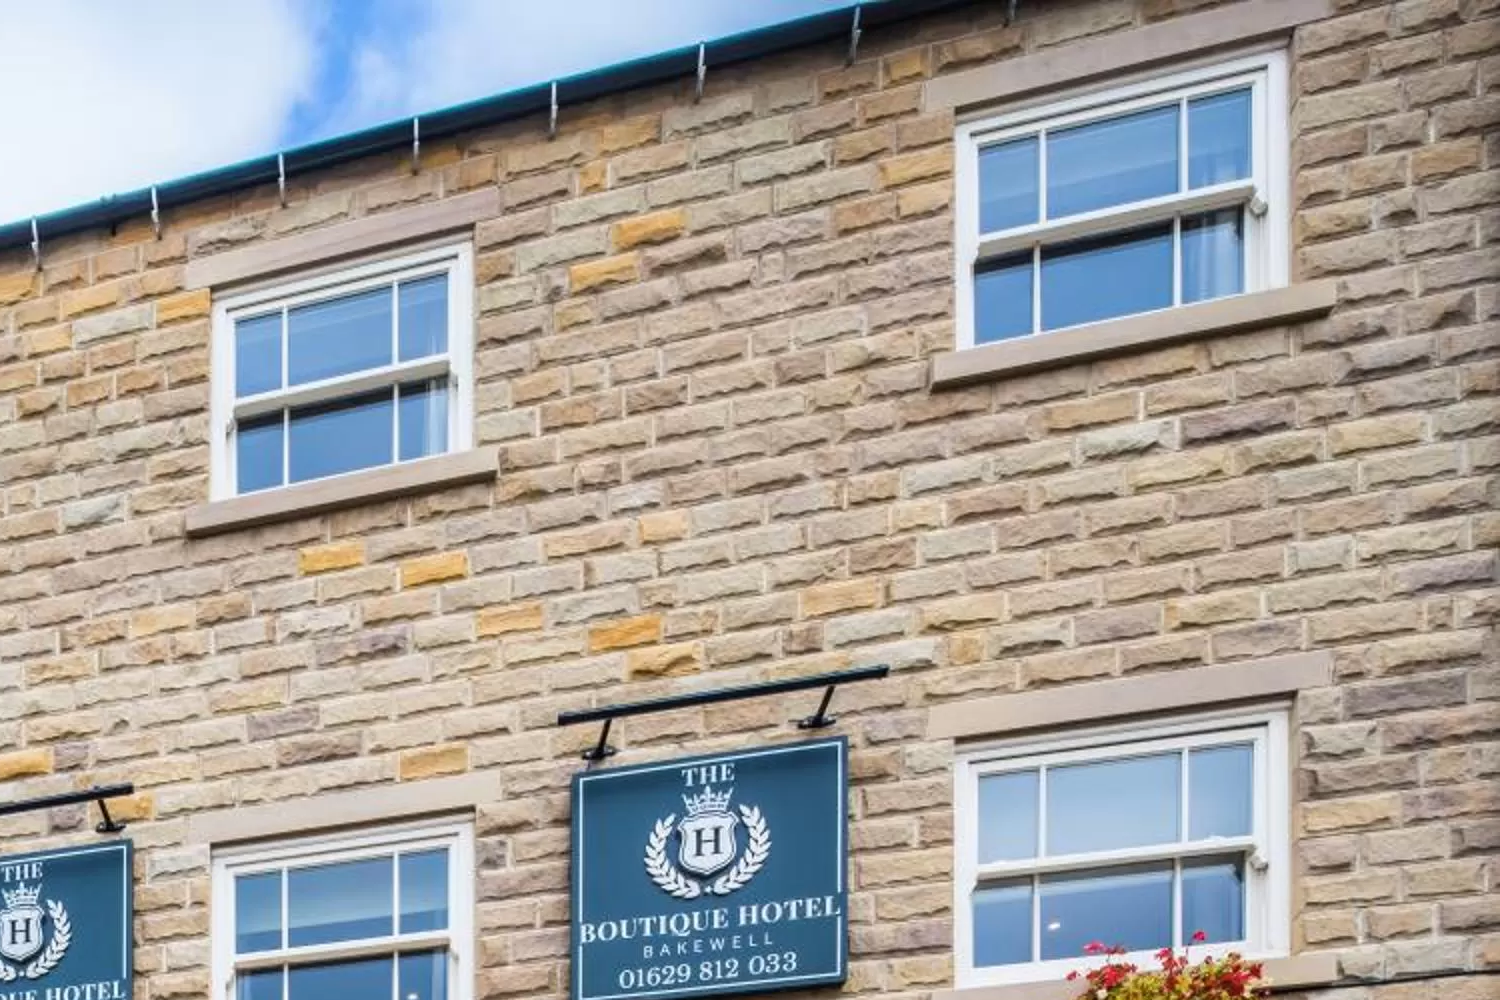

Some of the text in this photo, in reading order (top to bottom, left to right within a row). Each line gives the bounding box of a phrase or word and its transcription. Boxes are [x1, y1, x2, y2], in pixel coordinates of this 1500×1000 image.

[682, 763, 735, 787] THE
[694, 826, 722, 857] H
[1, 861, 43, 883] THE
[10, 917, 32, 945] H
[580, 895, 841, 944] BOUTIQUE HOTEL
[643, 932, 773, 959] BAKEWELL
[619, 951, 798, 990] 01629 812 033
